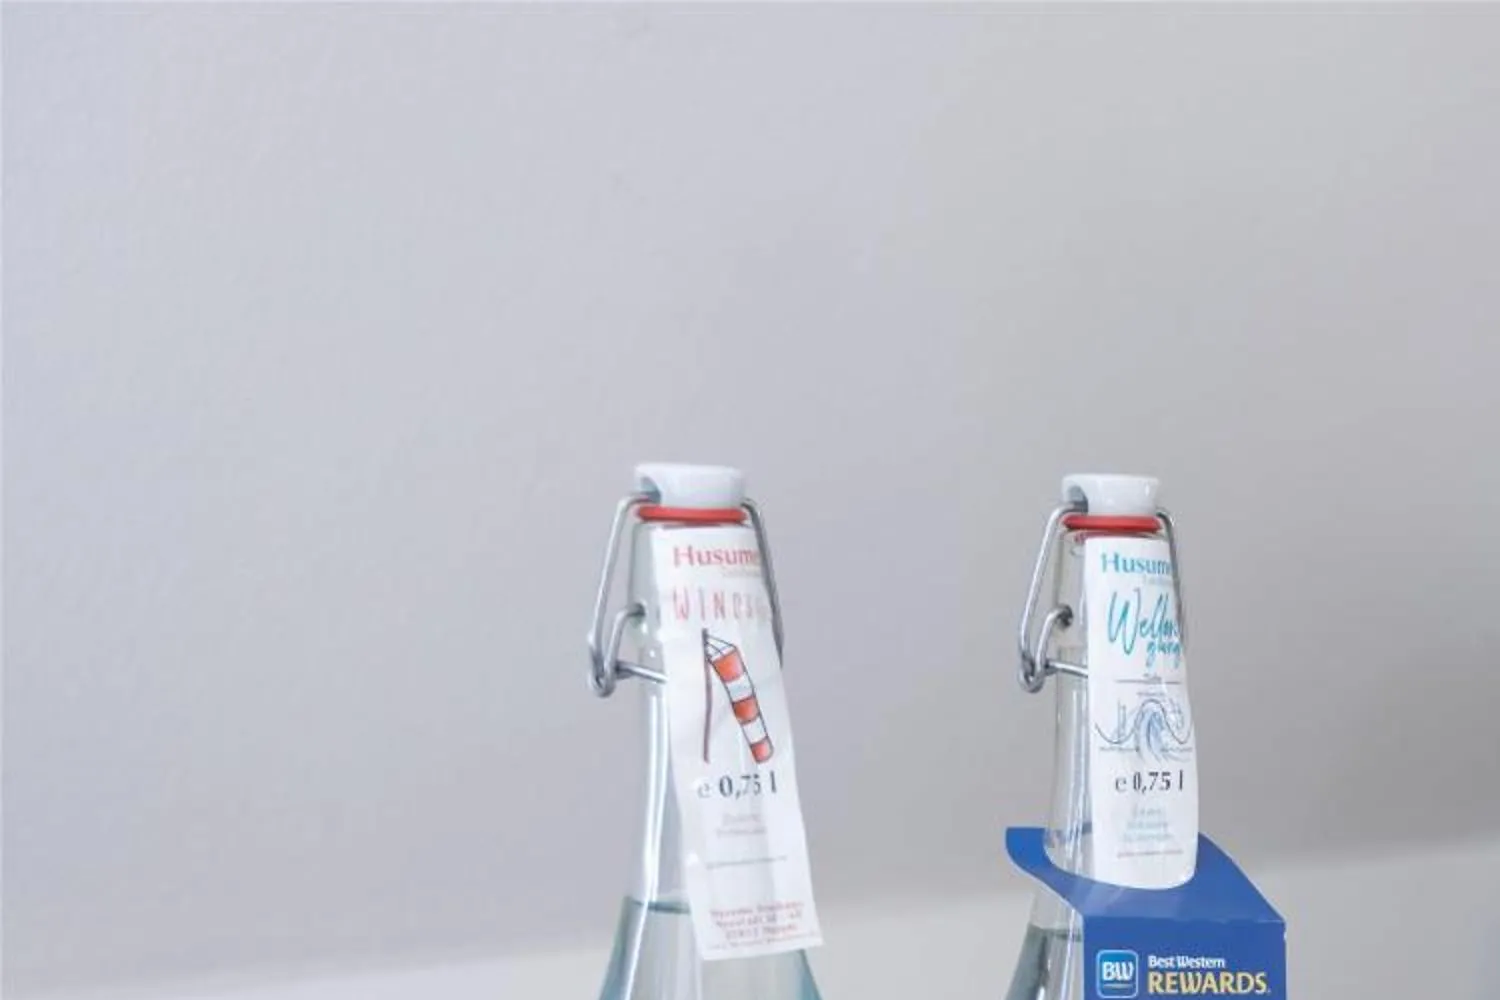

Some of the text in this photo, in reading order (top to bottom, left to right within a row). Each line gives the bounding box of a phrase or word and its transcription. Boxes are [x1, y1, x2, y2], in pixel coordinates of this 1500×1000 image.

[1100, 552, 1173, 575] Husum
[719, 773, 761, 800] 0,75
[1133, 771, 1171, 795] 0,75
[1101, 960, 1134, 982] BW
[1148, 956, 1226, 970] Best Western
[1148, 971, 1268, 996] REWARDS
